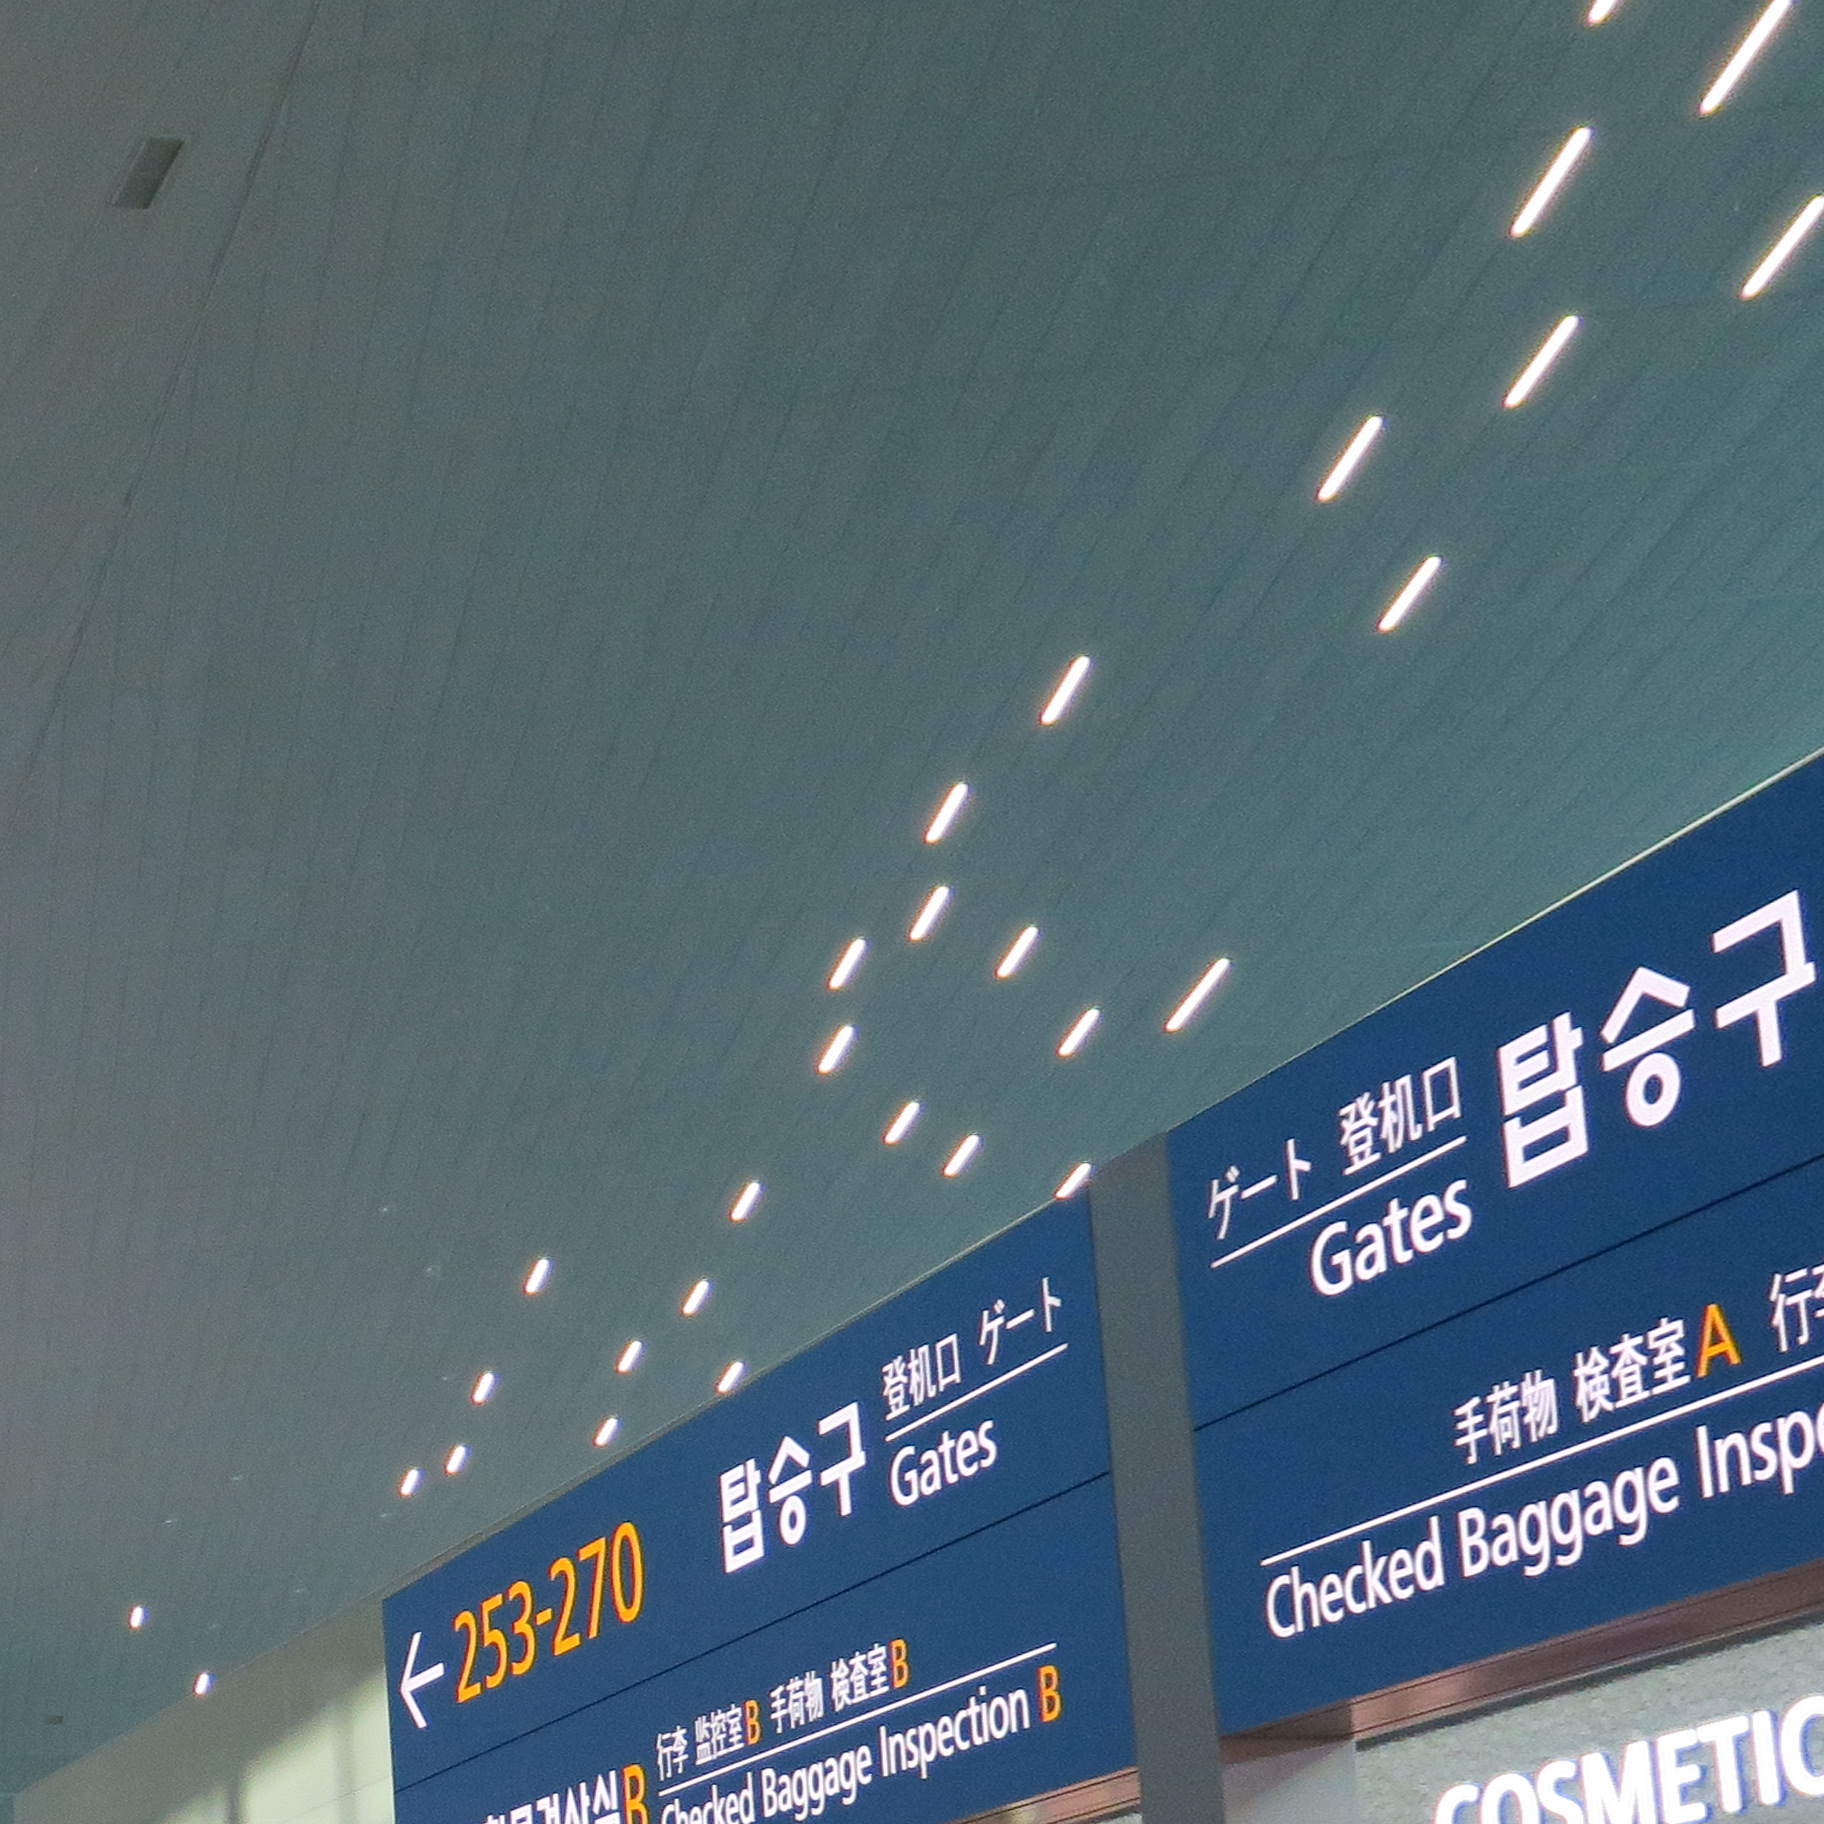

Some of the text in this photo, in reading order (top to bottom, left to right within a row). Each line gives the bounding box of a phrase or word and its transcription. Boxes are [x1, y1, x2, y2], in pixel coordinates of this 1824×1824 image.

[1498, 890, 1816, 1187] 탑승구
[1207, 1056, 1462, 1240] ゲート 登机口
[1310, 1178, 1472, 1297] Gates
[883, 1277, 1063, 1422] 登机口 ゲート
[1454, 1371, 1560, 1465] 手荷物
[719, 1401, 867, 1573] 탑승구
[889, 1417, 998, 1507] Gates
[1265, 1400, 1824, 1639] Checked Baggage Insp
[454, 1521, 645, 1704] 253-270
[761, 1743, 873, 1824] Baggage
[879, 1683, 1030, 1778] Inspection
[1038, 1663, 1062, 1723] B
[770, 1676, 824, 1735] 手荷物
